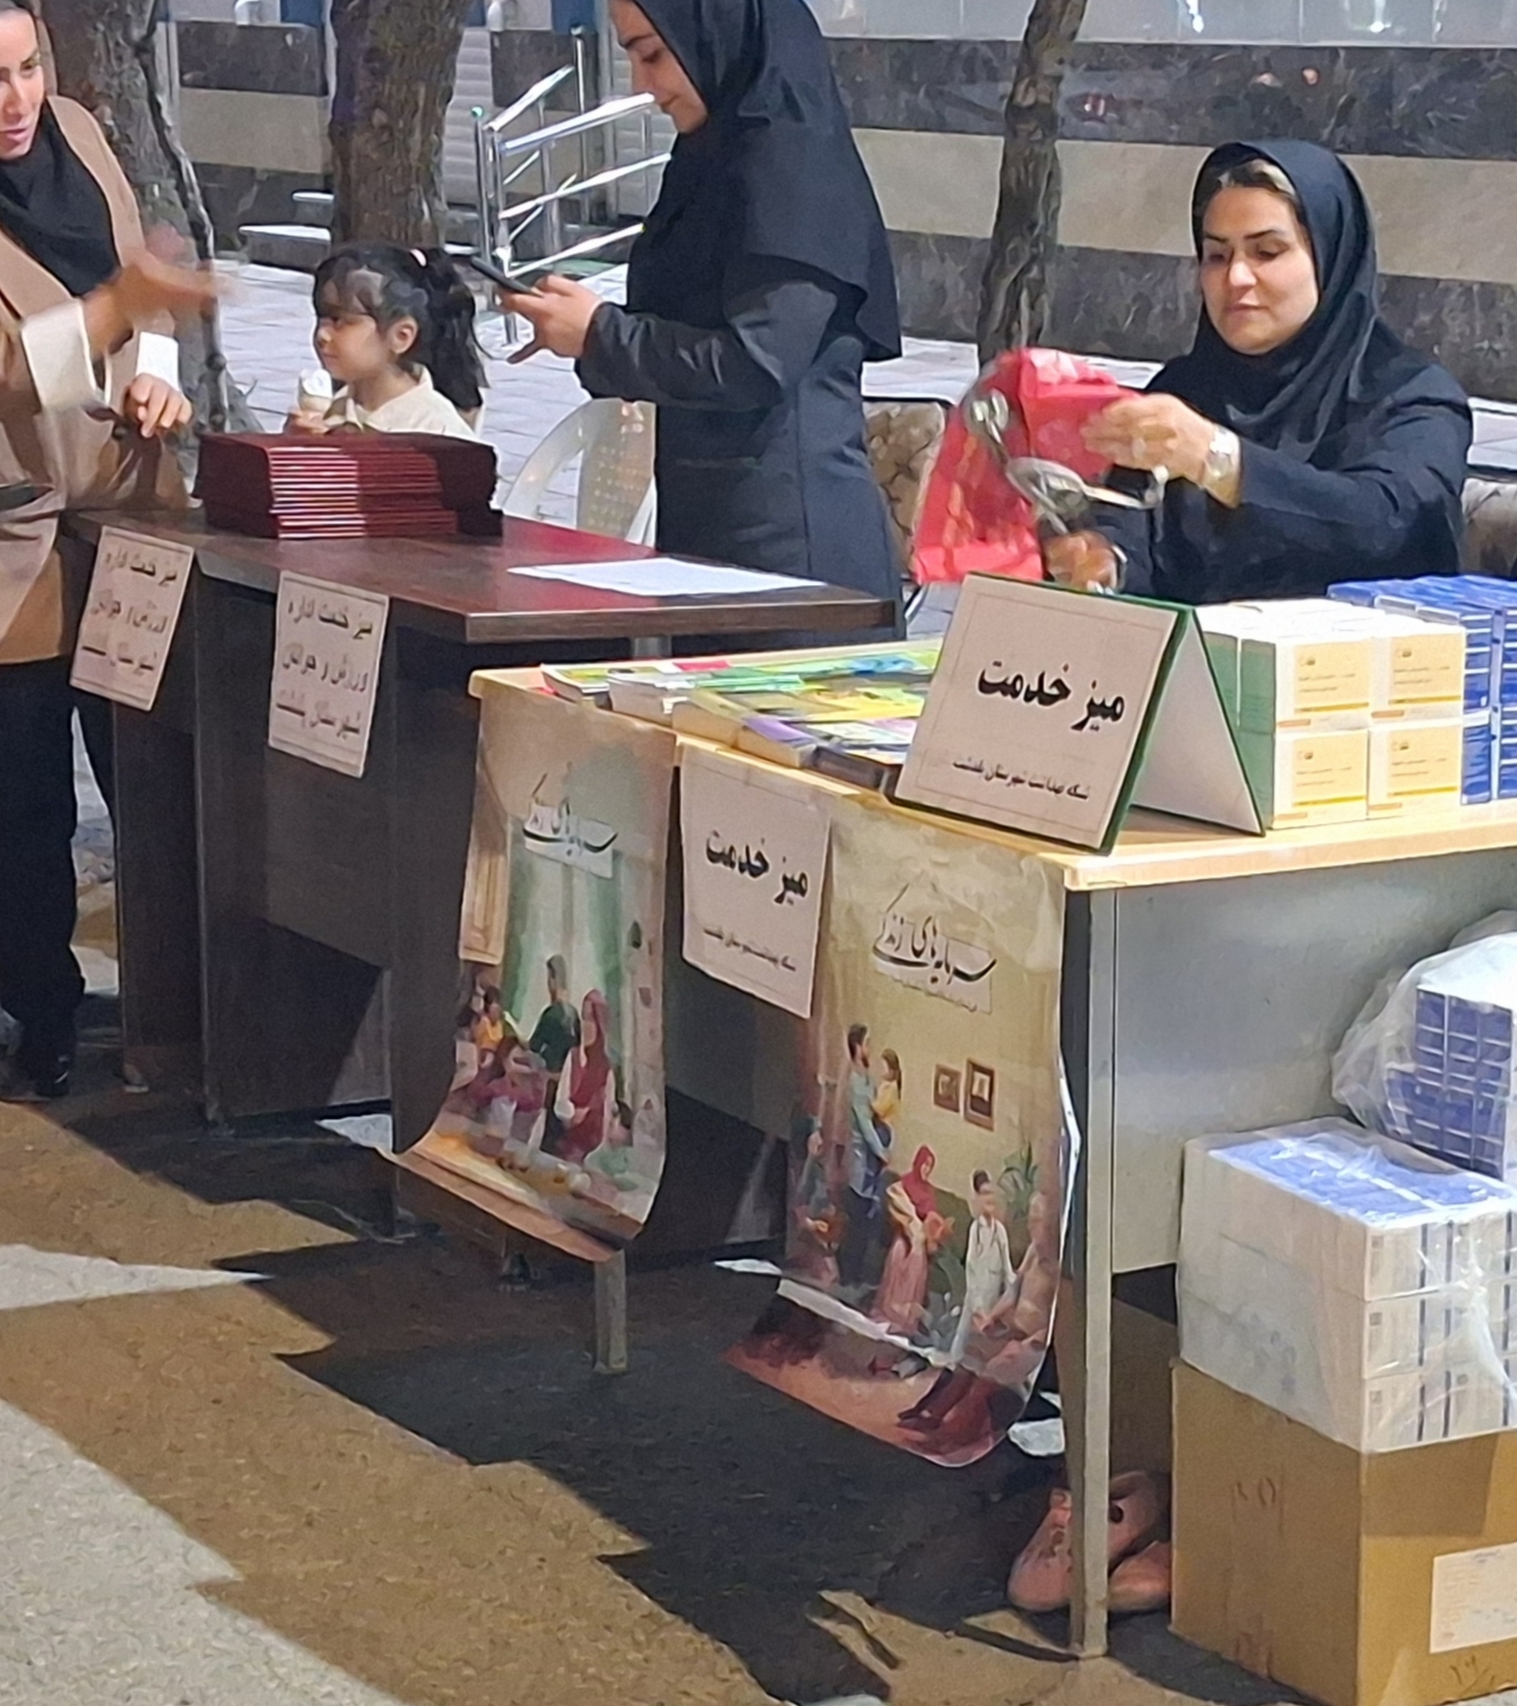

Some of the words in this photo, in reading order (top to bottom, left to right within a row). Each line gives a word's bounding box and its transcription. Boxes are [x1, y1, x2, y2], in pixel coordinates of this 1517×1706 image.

[976, 658, 1073, 708] خدمت
[1070, 678, 1127, 732] میز
[705, 829, 770, 879] خدمت
[773, 855, 809, 906] میز
